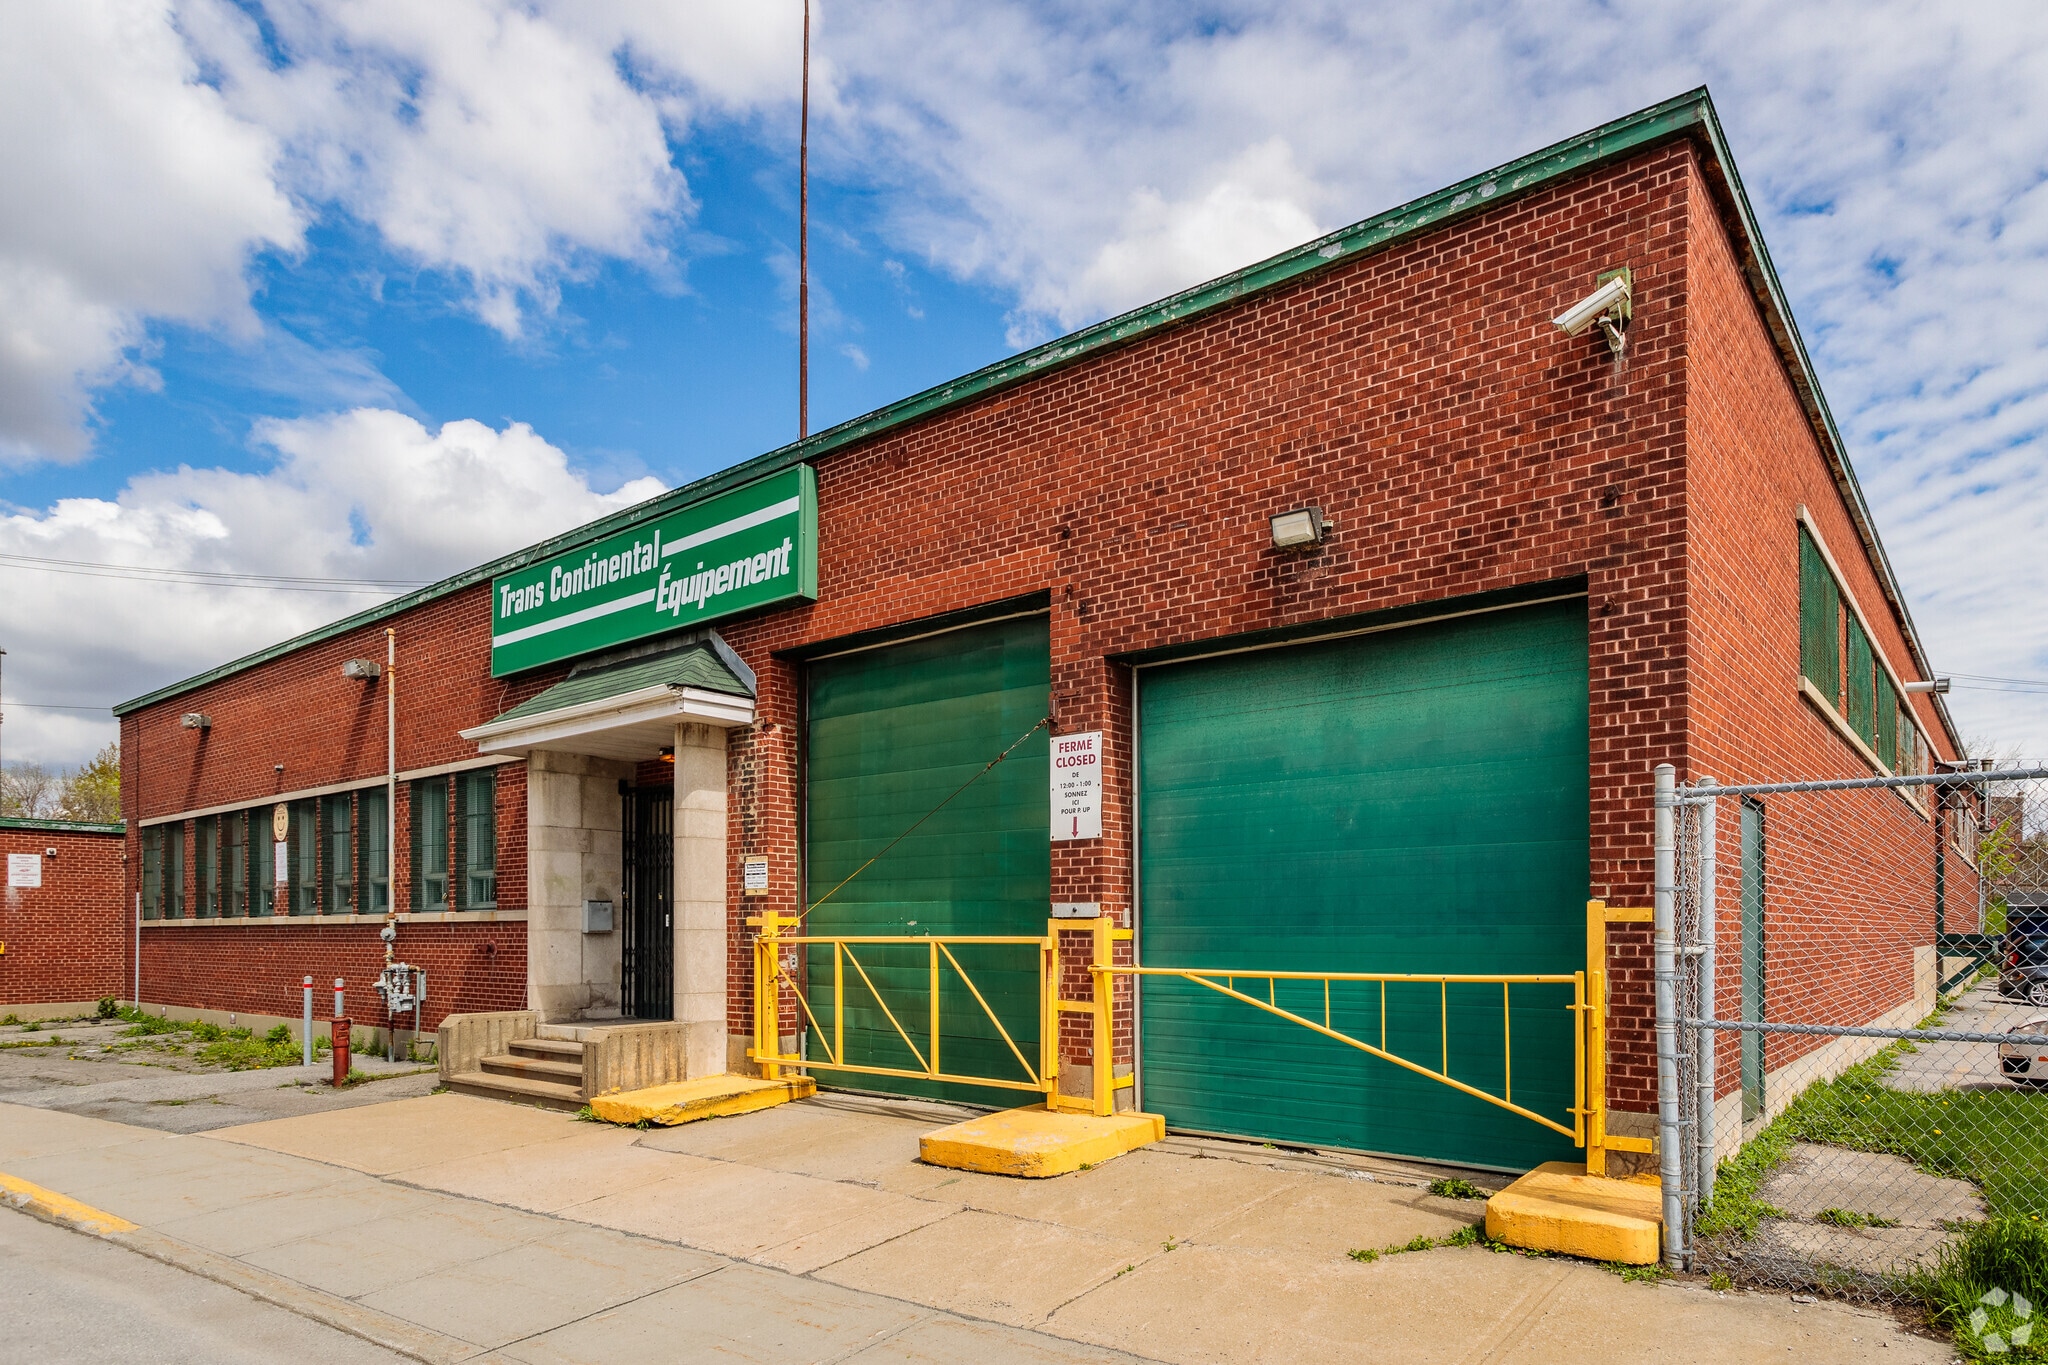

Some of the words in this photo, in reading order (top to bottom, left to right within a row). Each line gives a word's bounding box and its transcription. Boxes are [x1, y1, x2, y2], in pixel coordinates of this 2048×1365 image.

[500, 583, 545, 618] Trans
[550, 529, 660, 602] Continental
[655, 536, 793, 617] Équipement
[1059, 736, 1093, 753] FERMÉ
[1056, 753, 1096, 768] CLOSED
[1064, 790, 1087, 798] SONNEZ
